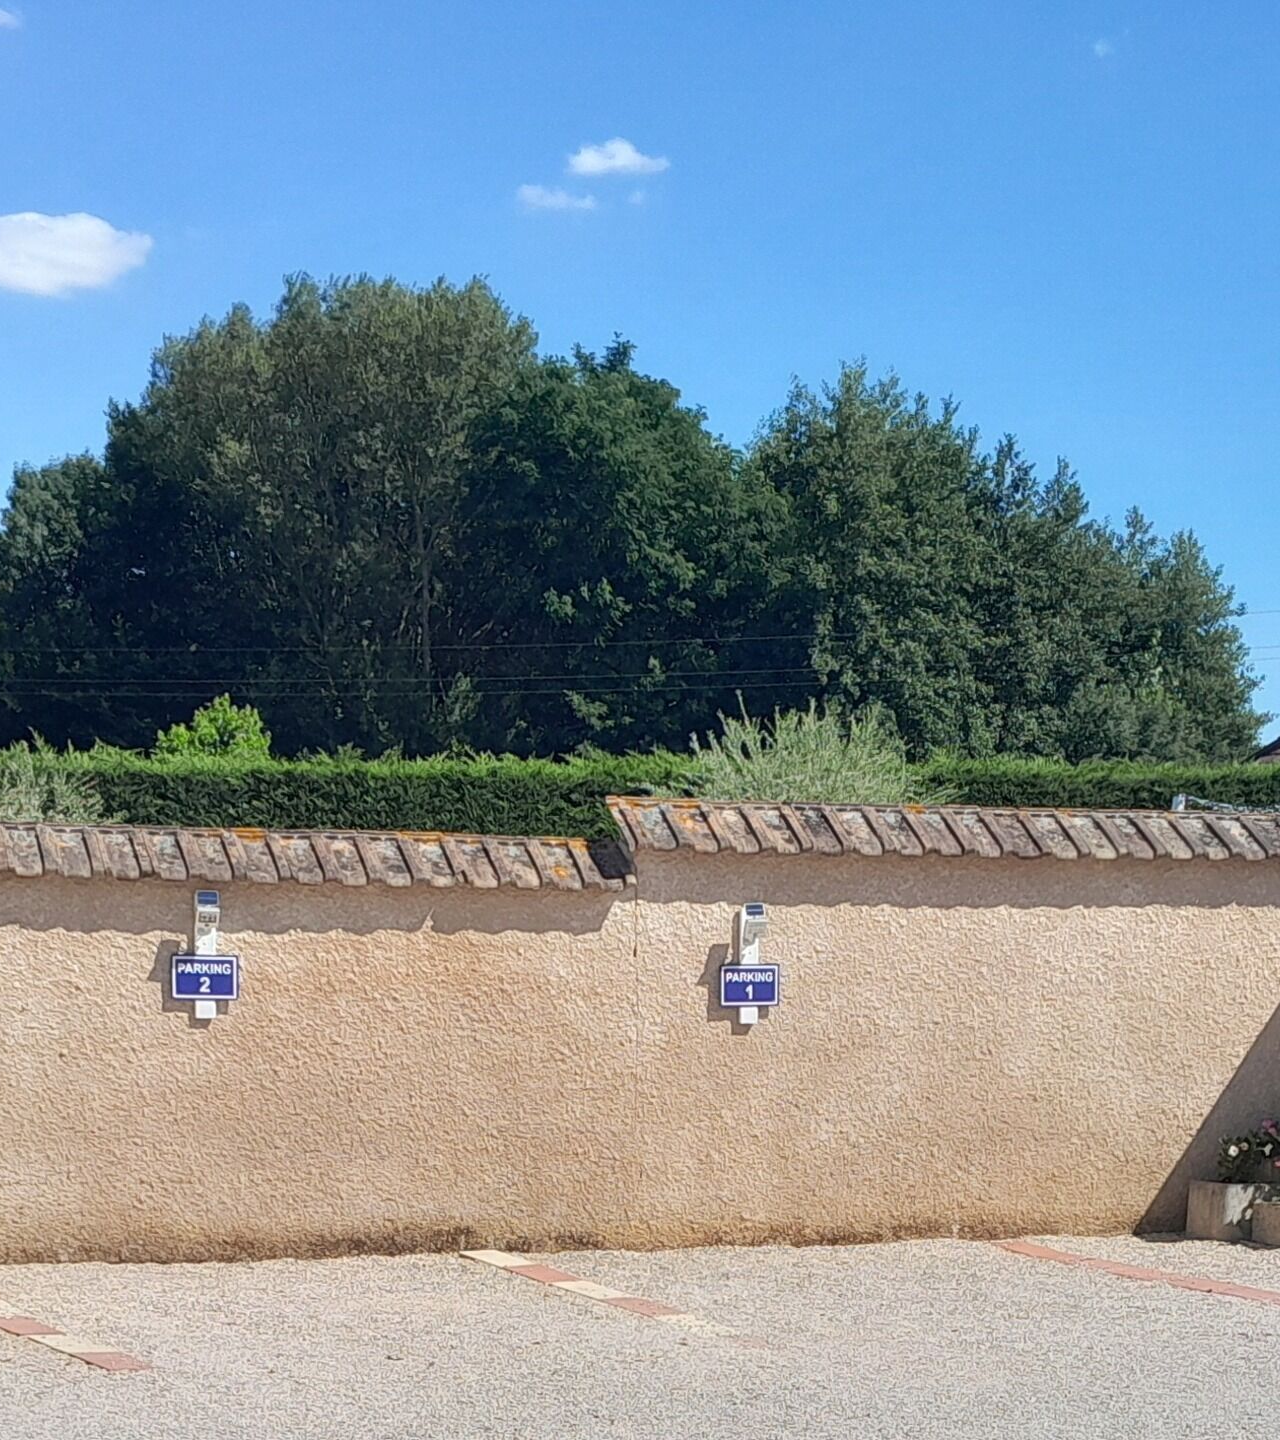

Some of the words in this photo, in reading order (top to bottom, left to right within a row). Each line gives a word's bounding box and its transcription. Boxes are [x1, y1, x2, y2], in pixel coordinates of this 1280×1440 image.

[177, 963, 232, 975] PARKING
[725, 971, 774, 983] PARKING
[199, 976, 211, 993] 2
[745, 984, 753, 1000] 1
